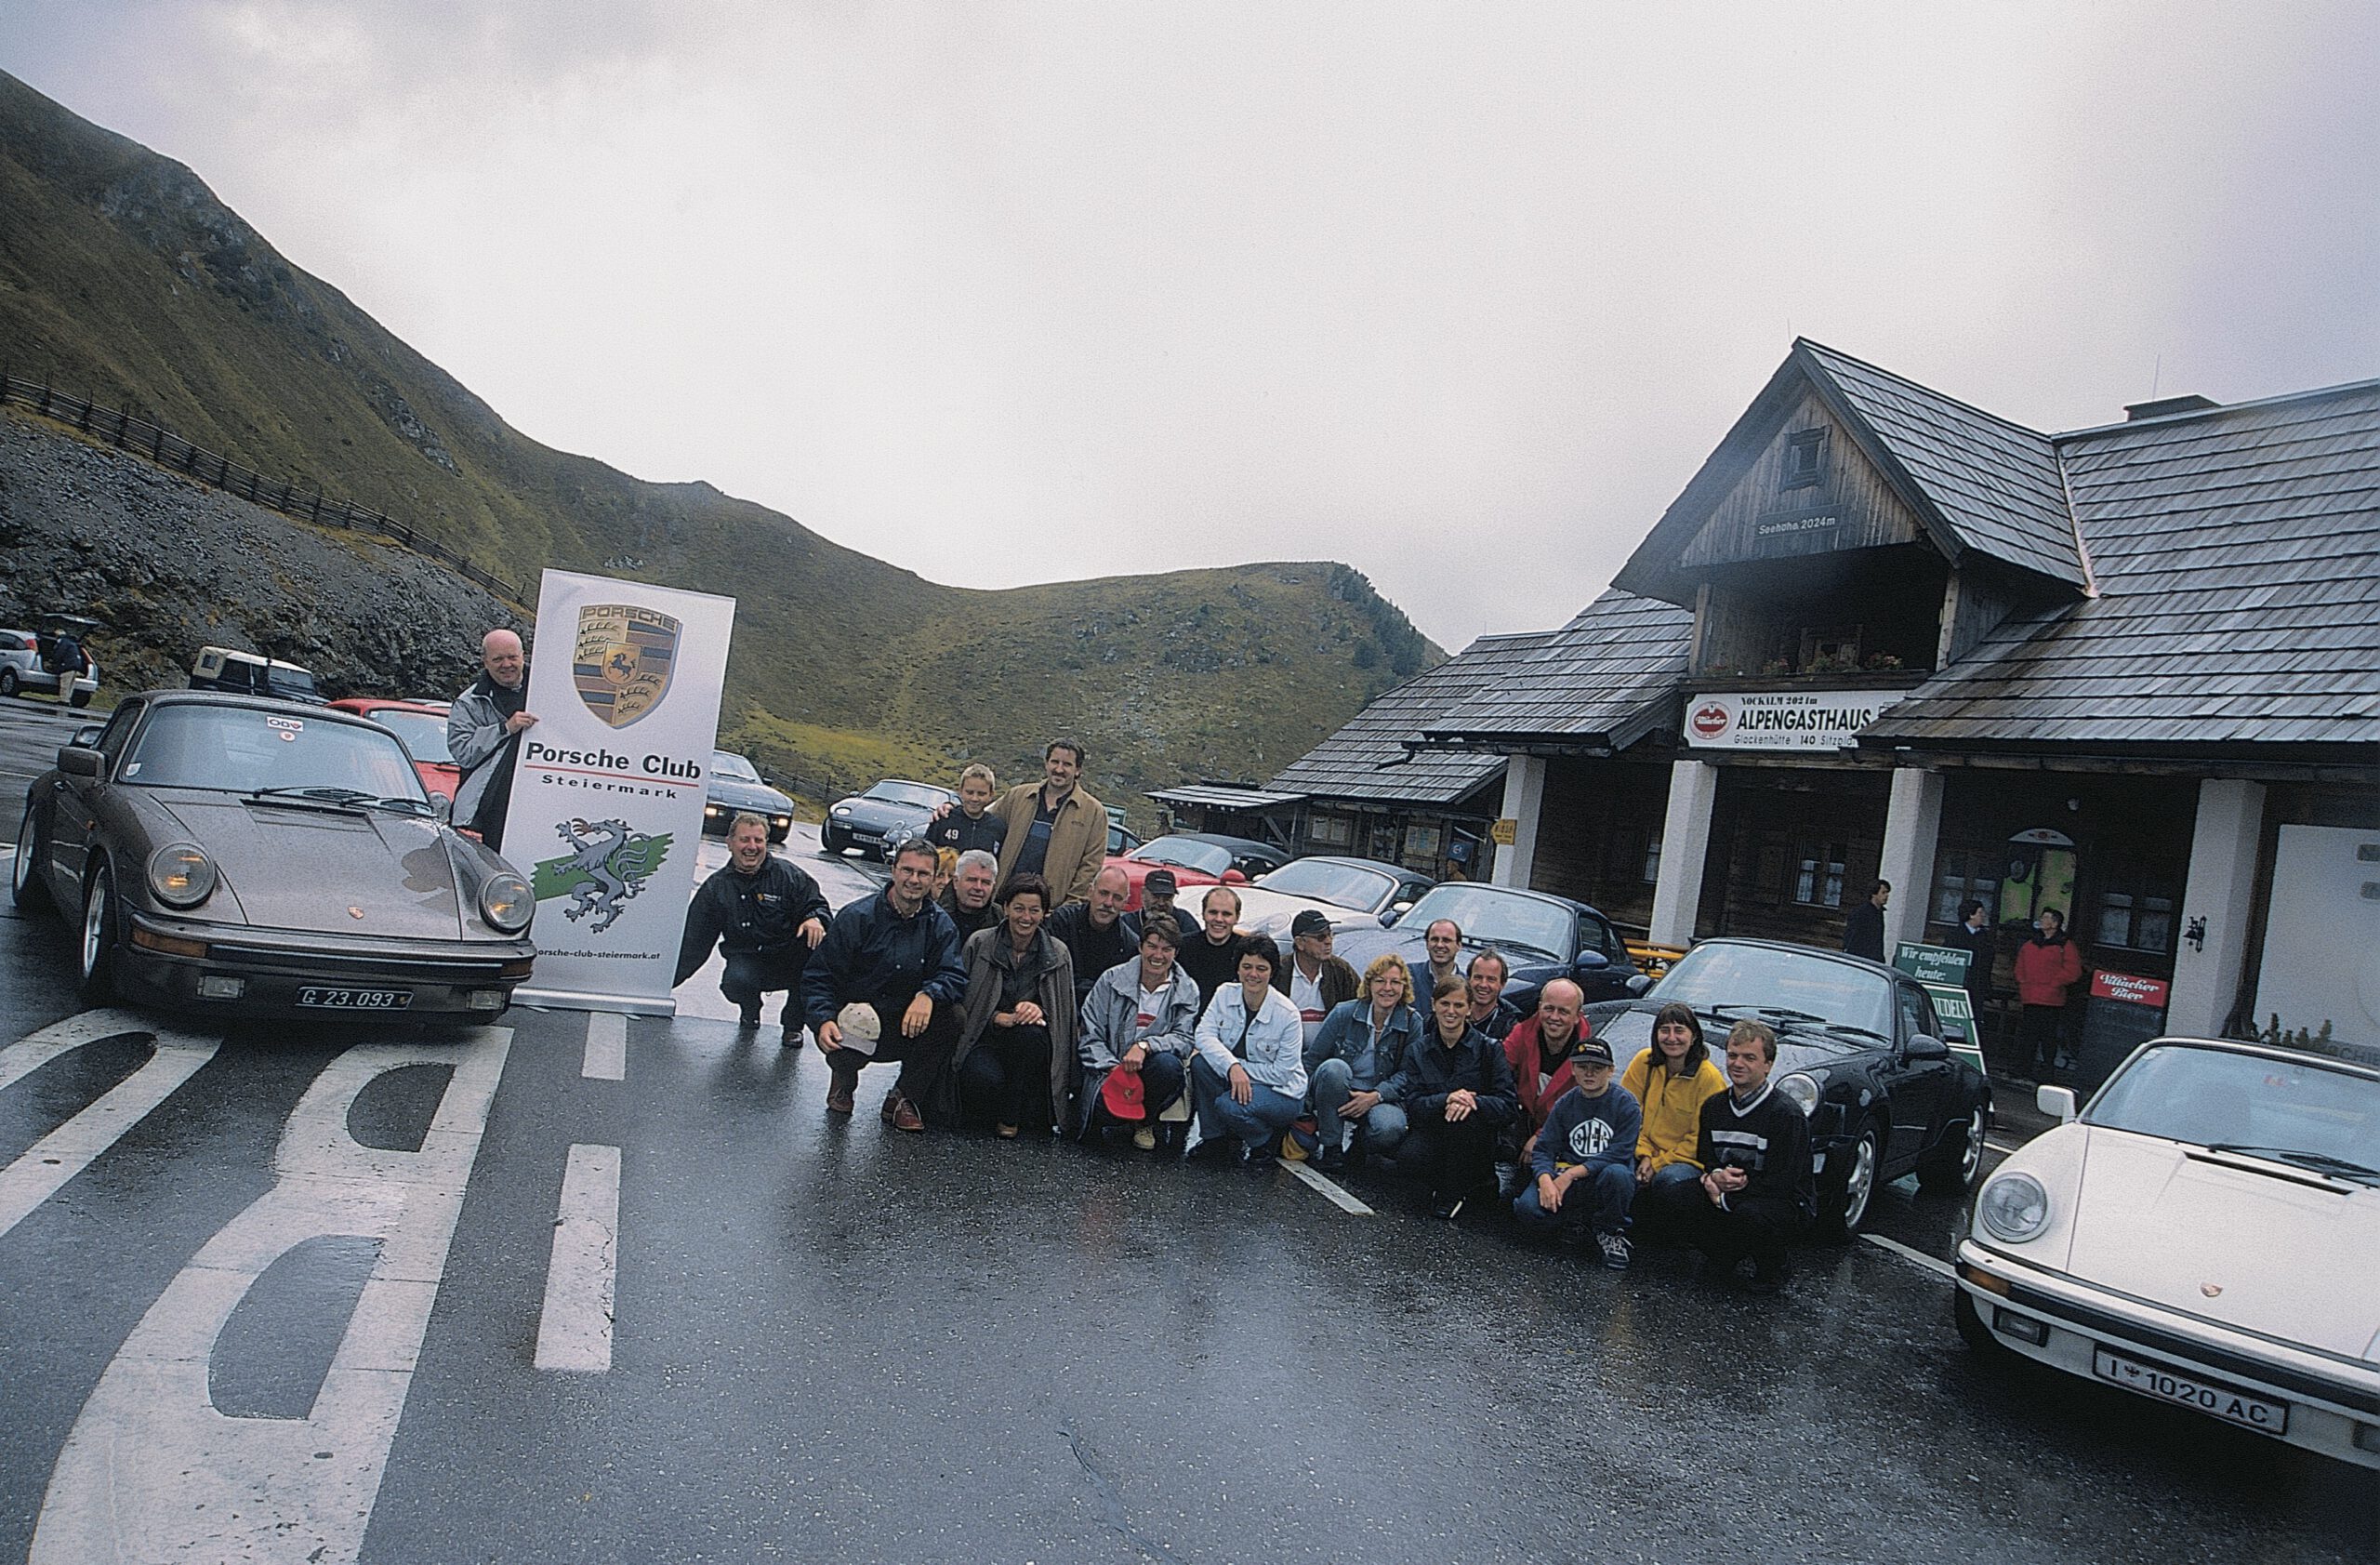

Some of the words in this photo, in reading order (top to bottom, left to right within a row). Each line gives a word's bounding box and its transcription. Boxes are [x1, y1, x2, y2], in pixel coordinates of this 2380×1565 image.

[581, 607, 677, 631] PORSCHE
[1736, 709, 1871, 731] ALPENGASTHAUS
[1734, 735, 1792, 745] Glockenhütte
[1800, 736, 1816, 745] 140
[525, 742, 630, 770] Porsche
[642, 754, 702, 779] Club
[541, 774, 678, 799] Steiermark
[945, 829, 959, 840] 49
[538, 948, 660, 960] orsche-club-steiermark.at
[1901, 947, 1918, 960] Wir
[1919, 951, 1966, 966] empfehlen
[1915, 966, 1947, 981] heute:
[302, 989, 317, 1004] G
[323, 991, 394, 1007] 23.093
[2110, 986, 2144, 1001] Bier
[2147, 1373, 2216, 1409] 1020
[2227, 1399, 2268, 1424] AC
